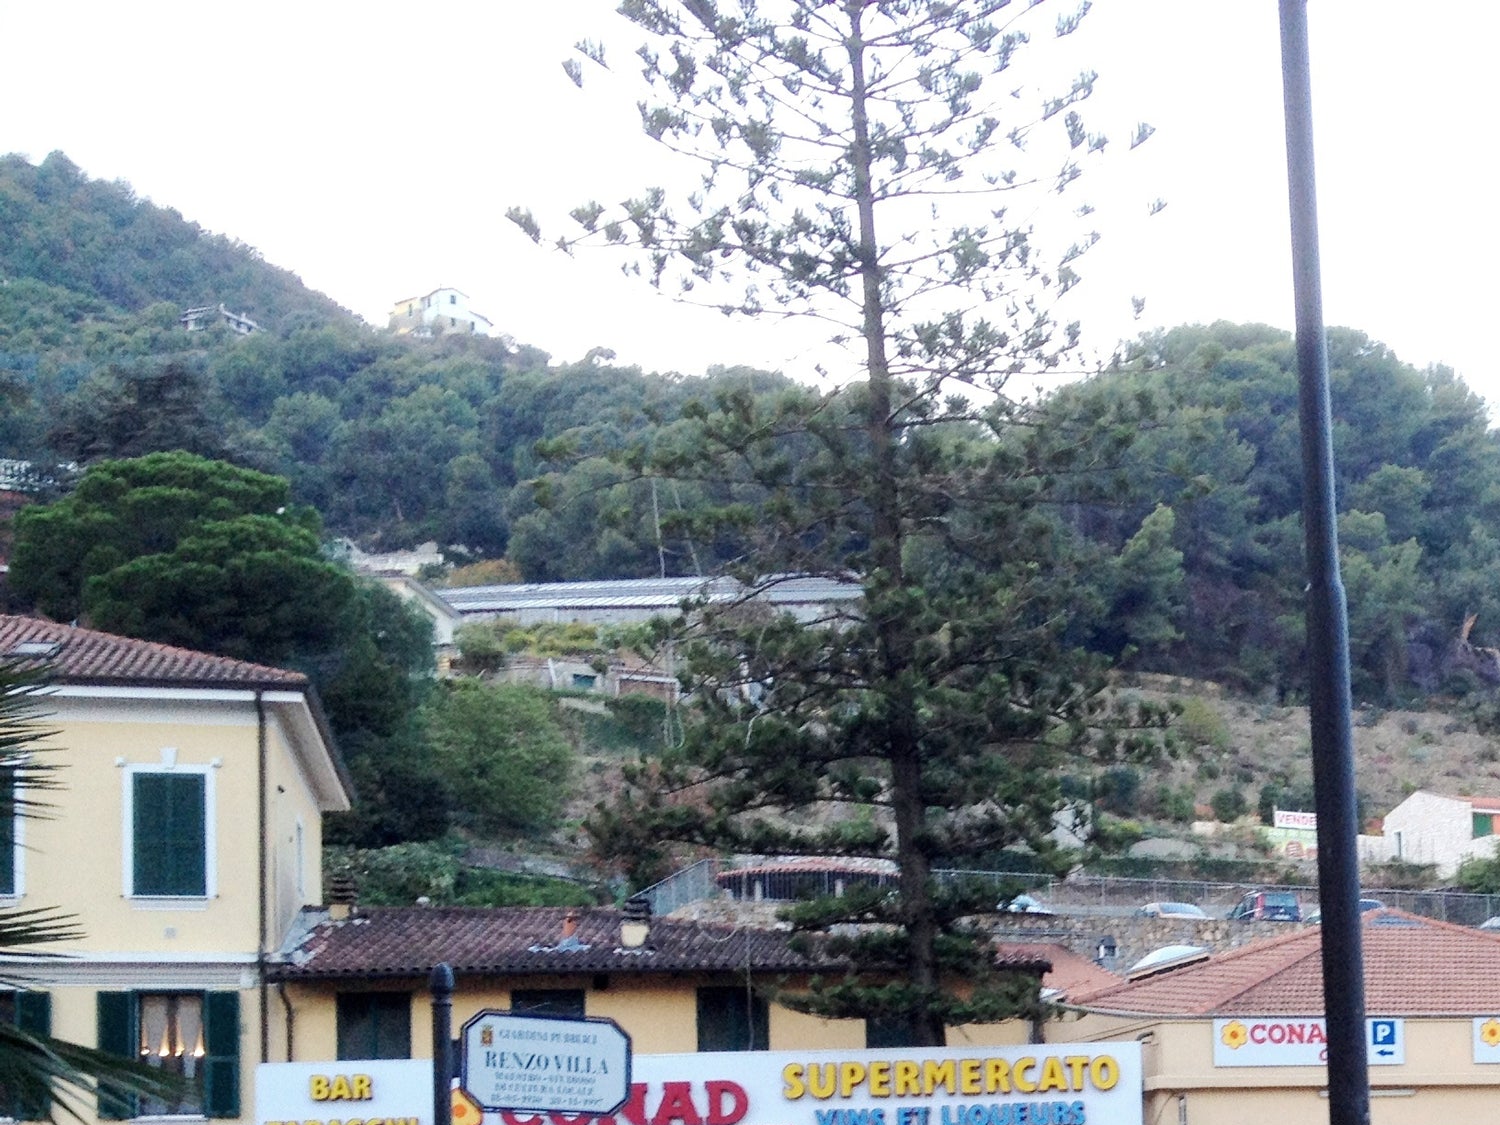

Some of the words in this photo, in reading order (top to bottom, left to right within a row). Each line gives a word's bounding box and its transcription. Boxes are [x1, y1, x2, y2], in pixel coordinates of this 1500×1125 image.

[1250, 1023, 1328, 1044] CONA
[485, 1050, 549, 1070] RENZO
[554, 1054, 609, 1074] VILLA
[309, 1074, 373, 1101] BAR
[782, 1054, 1120, 1100] SUPERMERCATO
